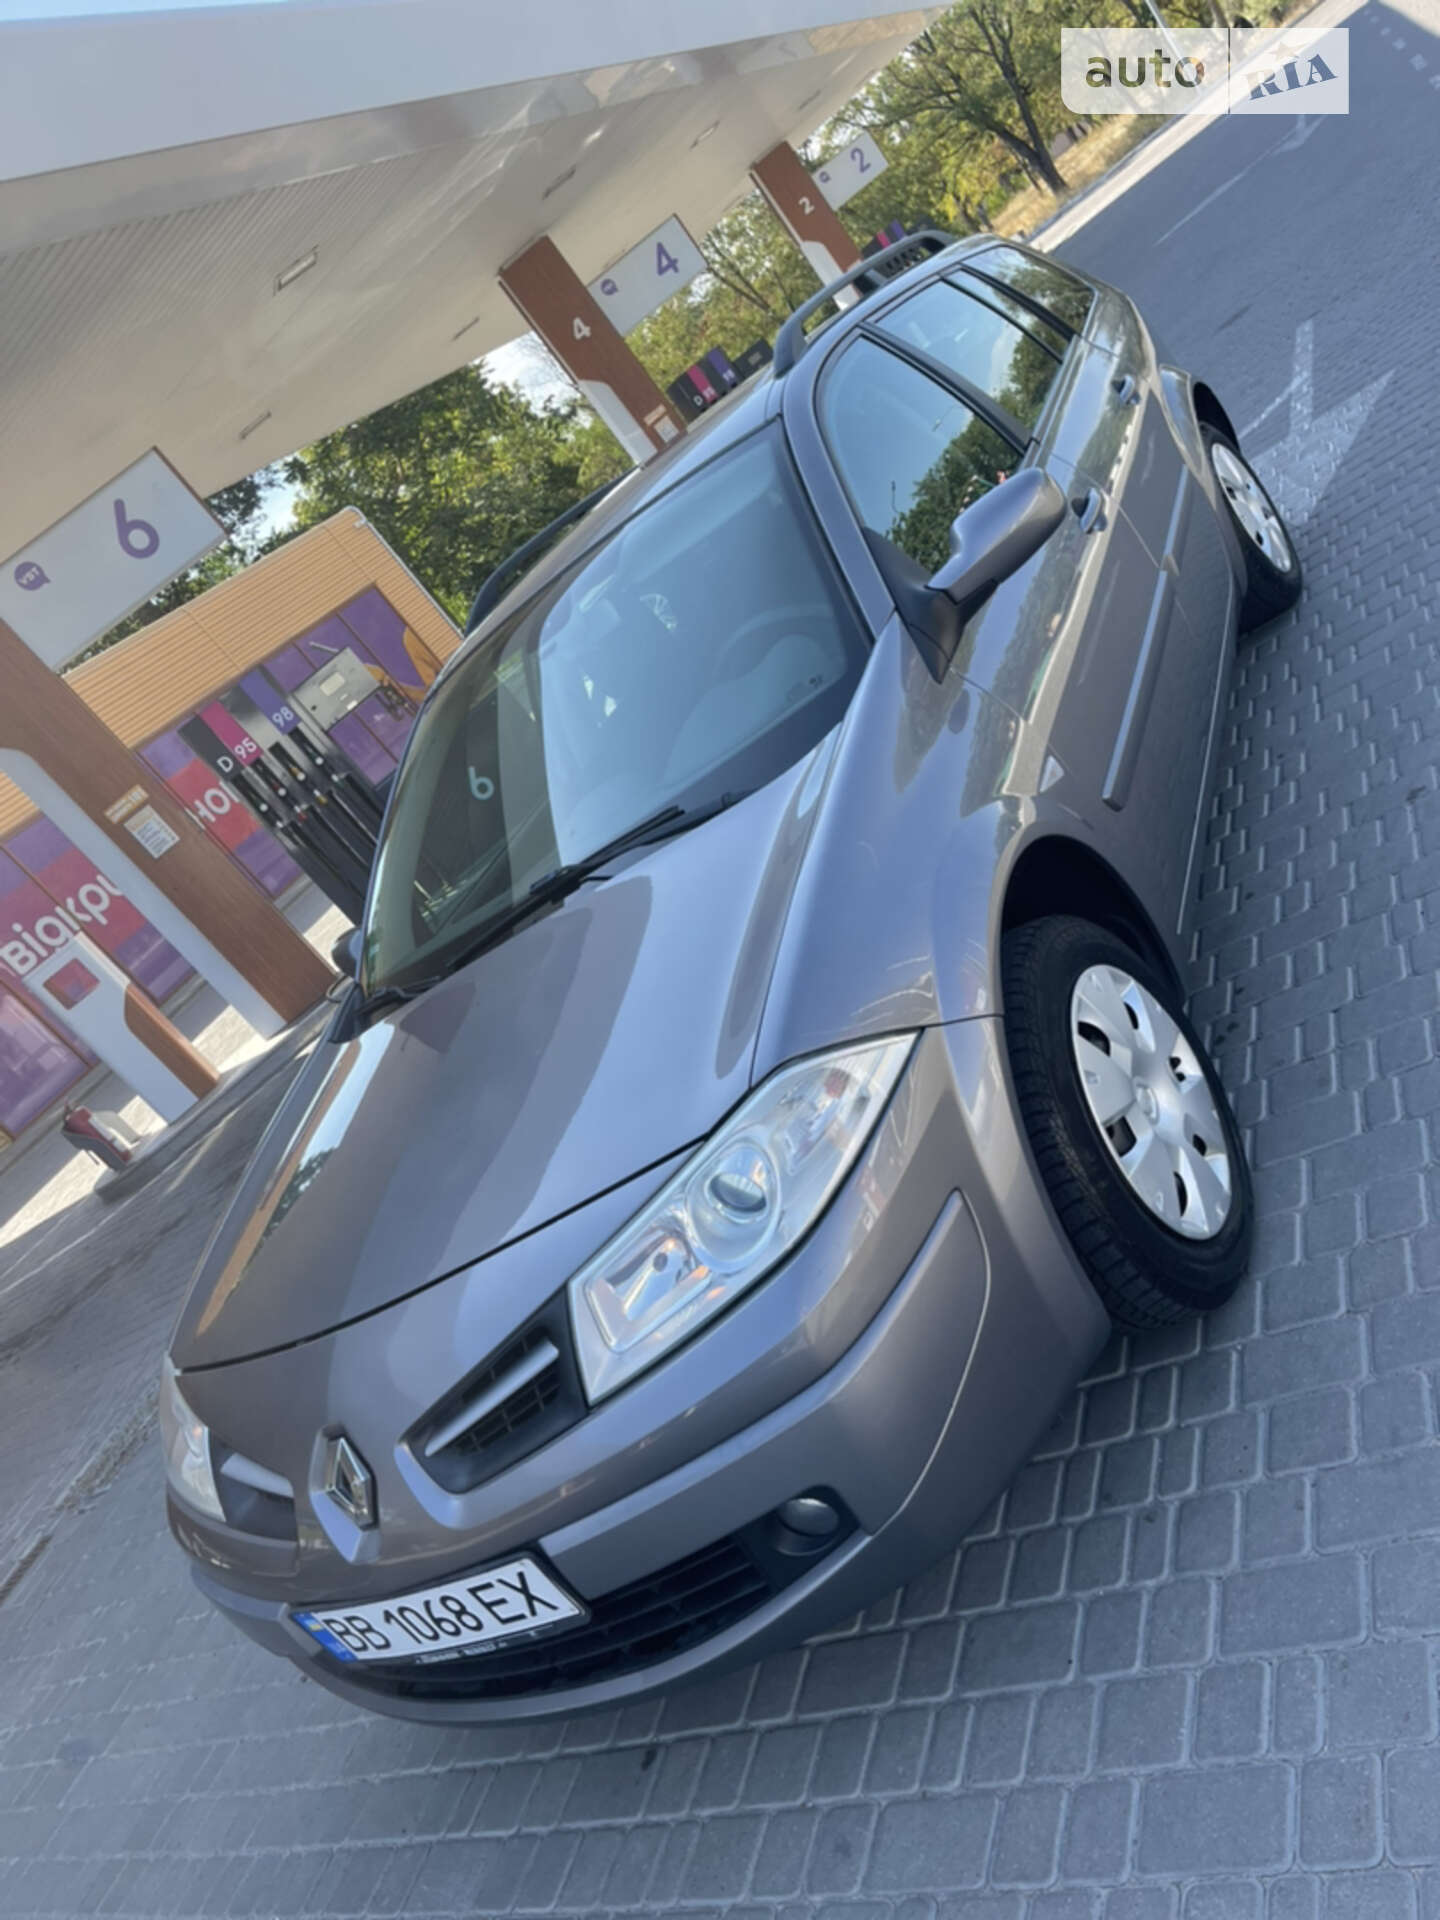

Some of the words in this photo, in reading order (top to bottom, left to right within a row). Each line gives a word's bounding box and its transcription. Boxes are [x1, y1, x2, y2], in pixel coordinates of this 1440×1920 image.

[850, 147, 872, 174] 2
[798, 196, 816, 216] 2
[656, 241, 679, 277] 4
[573, 317, 592, 340] 4
[113, 498, 160, 559] 6
[272, 706, 295, 728] 98
[234, 737, 258, 760] 95
[216, 756, 234, 774] D
[468, 766, 495, 800] 6
[322, 1618, 391, 1652] BB
[383, 1595, 484, 1645] 1068
[467, 1571, 558, 1626] EX
